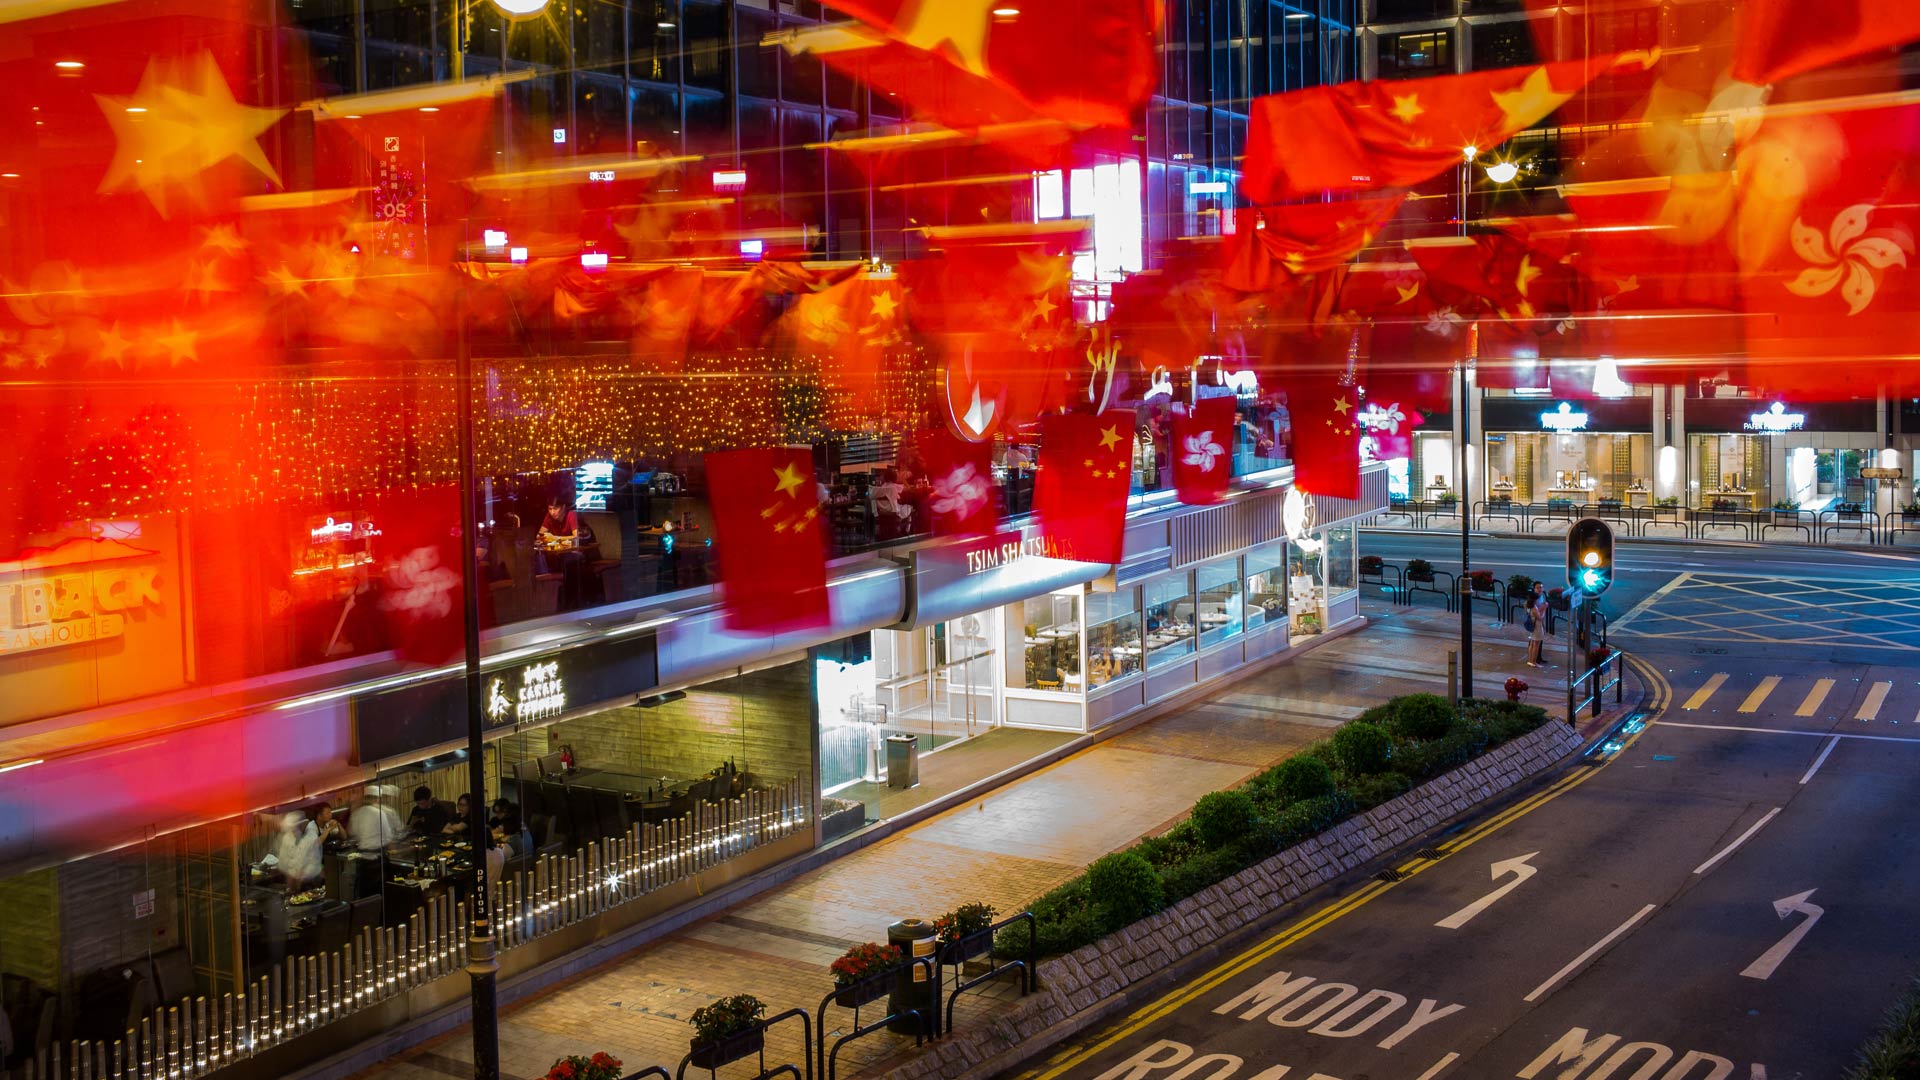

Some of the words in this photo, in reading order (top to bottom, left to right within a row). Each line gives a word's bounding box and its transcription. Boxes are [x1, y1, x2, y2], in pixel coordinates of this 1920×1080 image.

[966, 546, 999, 572] TSIM
[1002, 540, 1026, 565] SHA
[1212, 971, 1465, 1049] MODY
[1094, 1039, 1340, 1080] RO
